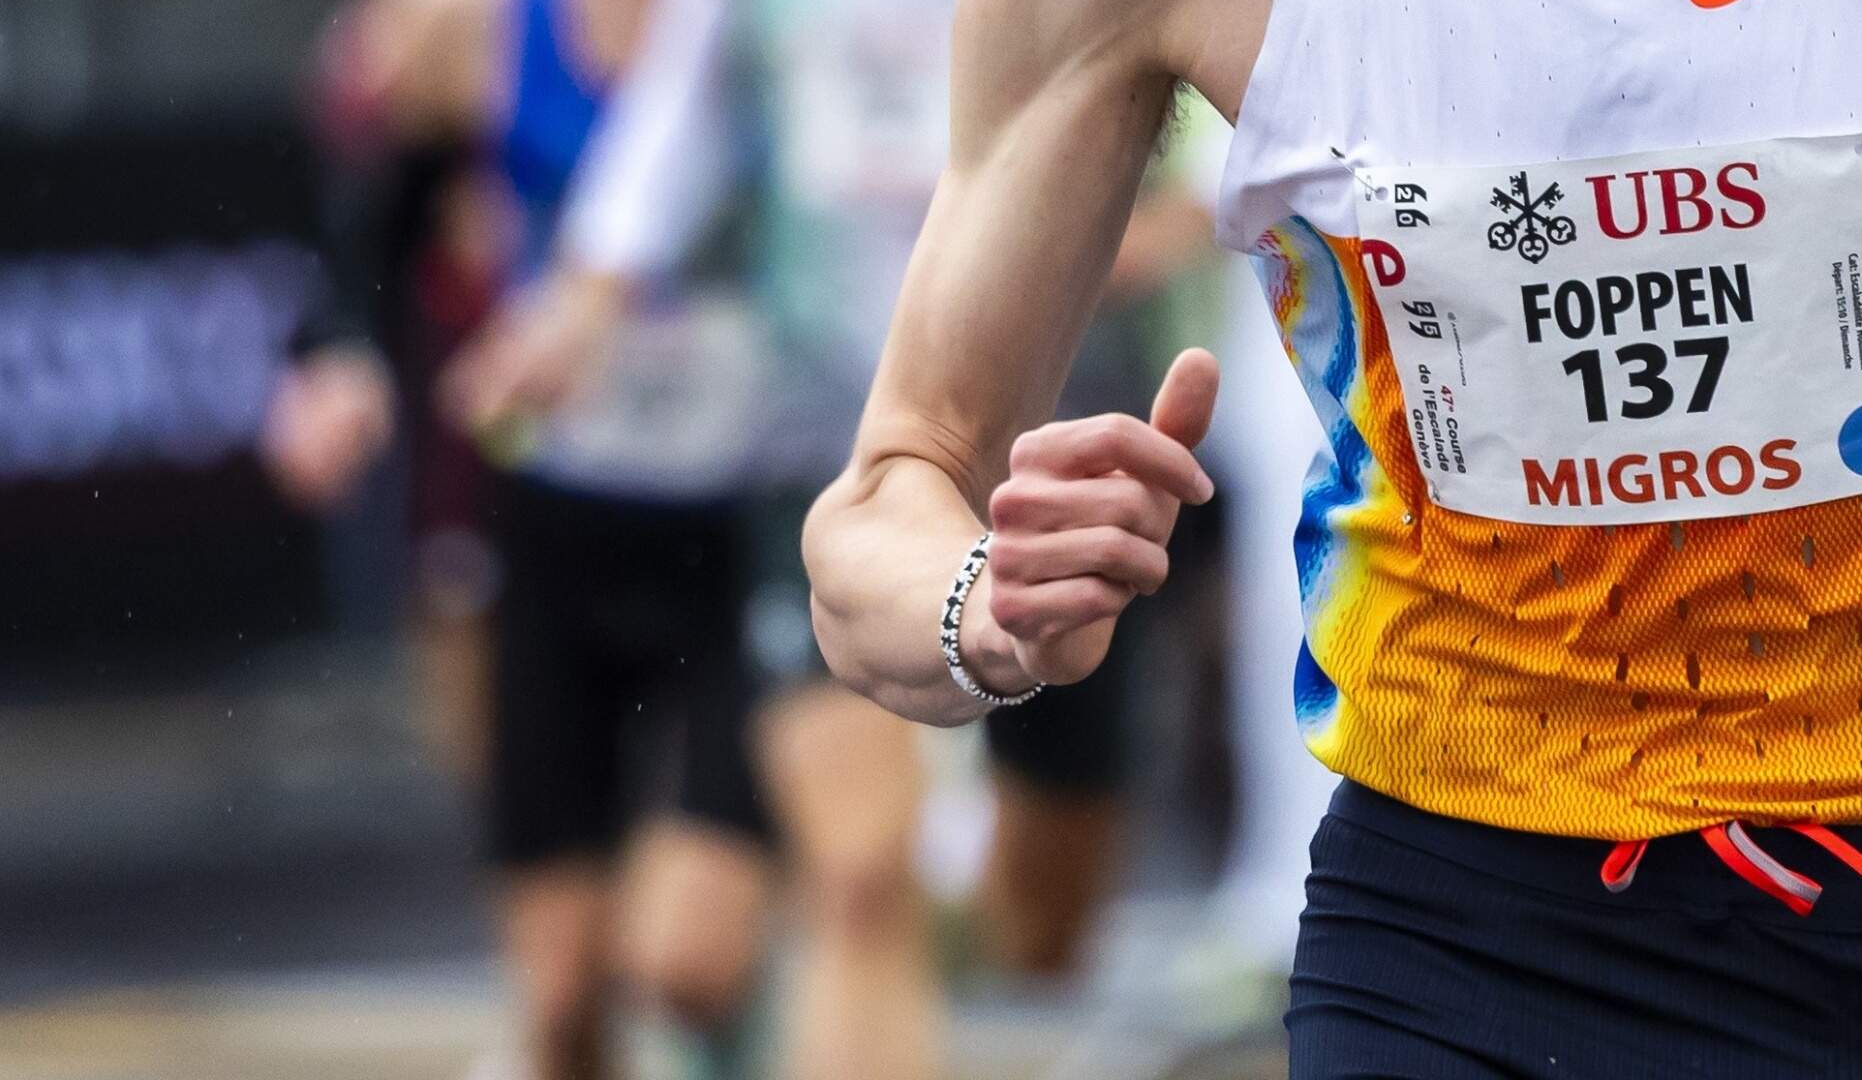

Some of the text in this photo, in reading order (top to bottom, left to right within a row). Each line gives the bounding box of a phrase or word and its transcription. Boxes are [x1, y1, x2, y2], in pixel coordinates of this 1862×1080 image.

[1585, 163, 1767, 240] UBS
[1848, 253, 1859, 272] Cat:
[1521, 263, 1754, 343] FOPPEN
[1561, 336, 1730, 423] 137
[1412, 408, 1432, 470] Genève
[1418, 363, 1450, 472] de l'Escalade
[1446, 416, 1467, 474] Course
[1521, 438, 1801, 507] MIGROS
